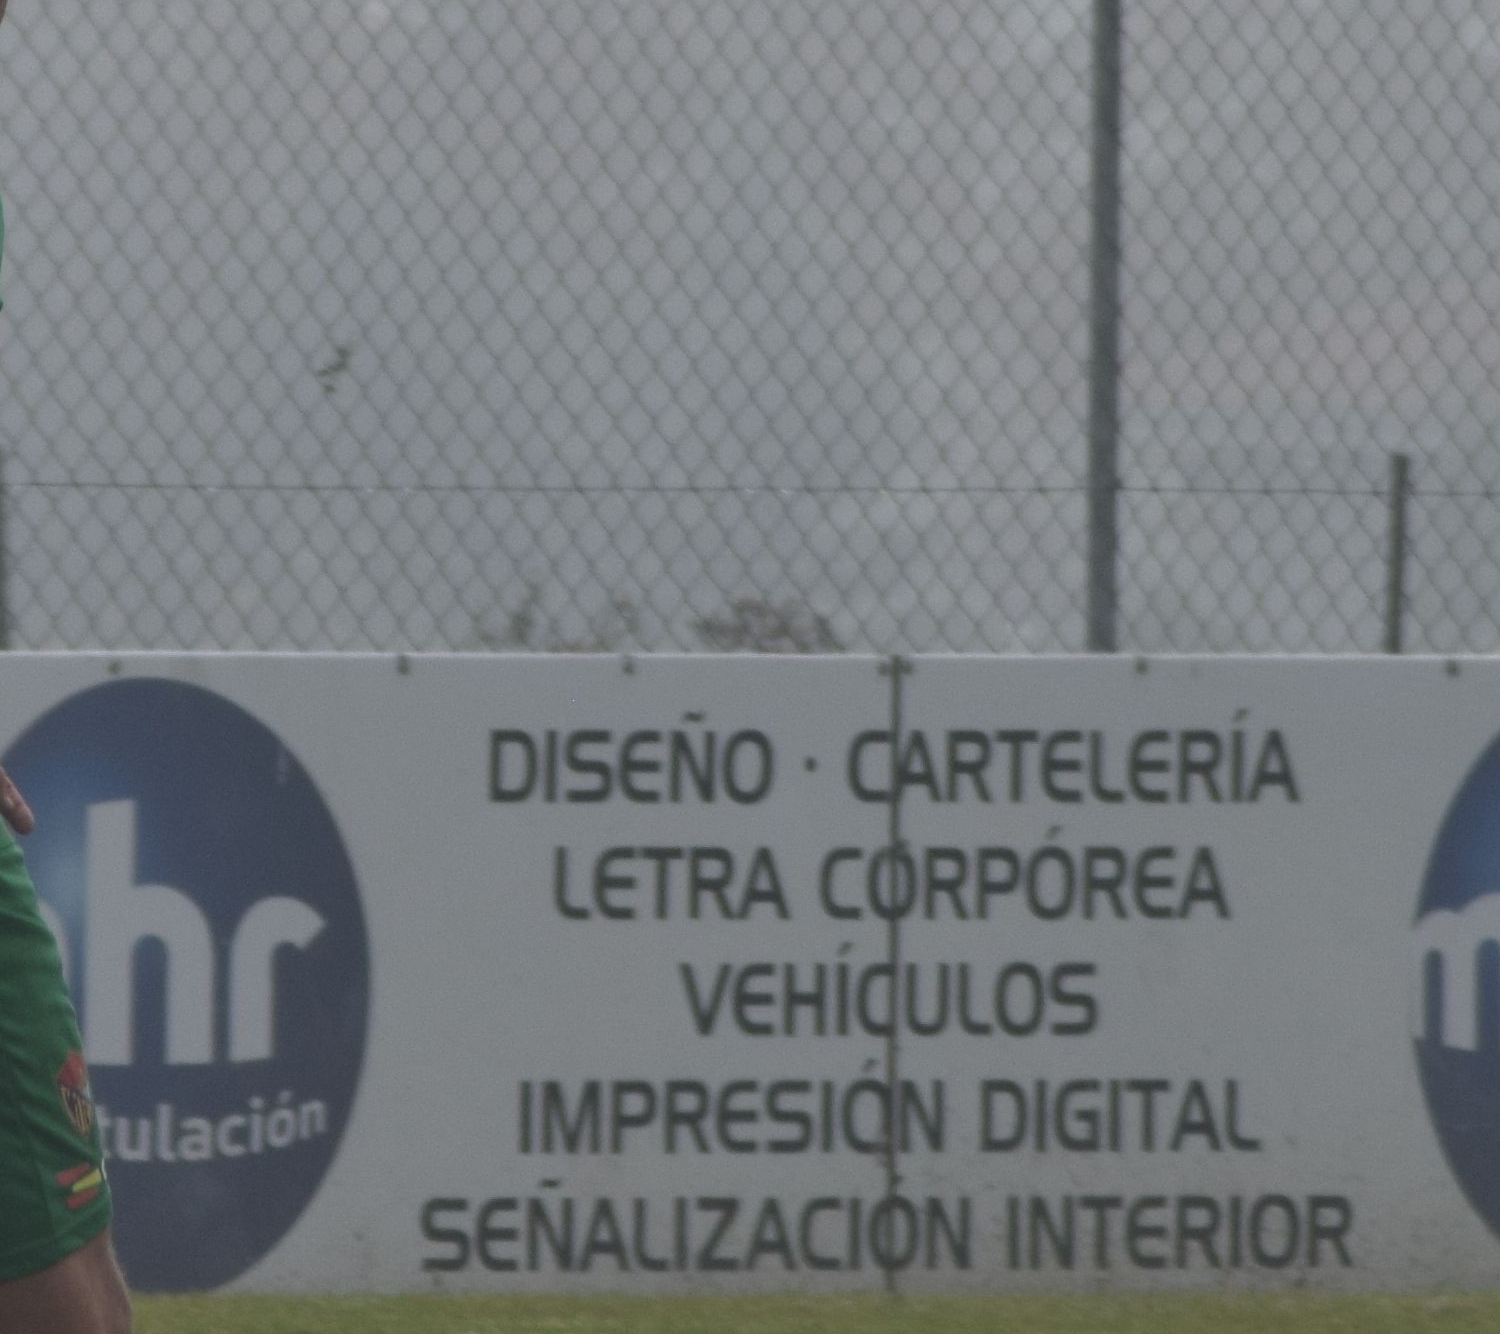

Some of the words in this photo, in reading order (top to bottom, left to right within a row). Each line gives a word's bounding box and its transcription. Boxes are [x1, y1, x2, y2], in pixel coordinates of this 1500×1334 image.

[488, 712, 774, 805] DISEÑO
[846, 709, 1302, 805] CARTELERÍA
[553, 845, 790, 922] LETRA
[818, 827, 1231, 922] CORPÓREA
[37, 798, 326, 1066] hr
[679, 942, 1099, 1037] VEHÍCULOS
[99, 1091, 327, 1163] tulación
[517, 1059, 945, 1155] IMPRESIÓN
[978, 1078, 1262, 1154] DIGITAL
[418, 1178, 972, 1272] SEÑALIZACIÓN
[1004, 1193, 1356, 1270] INTERIOR
